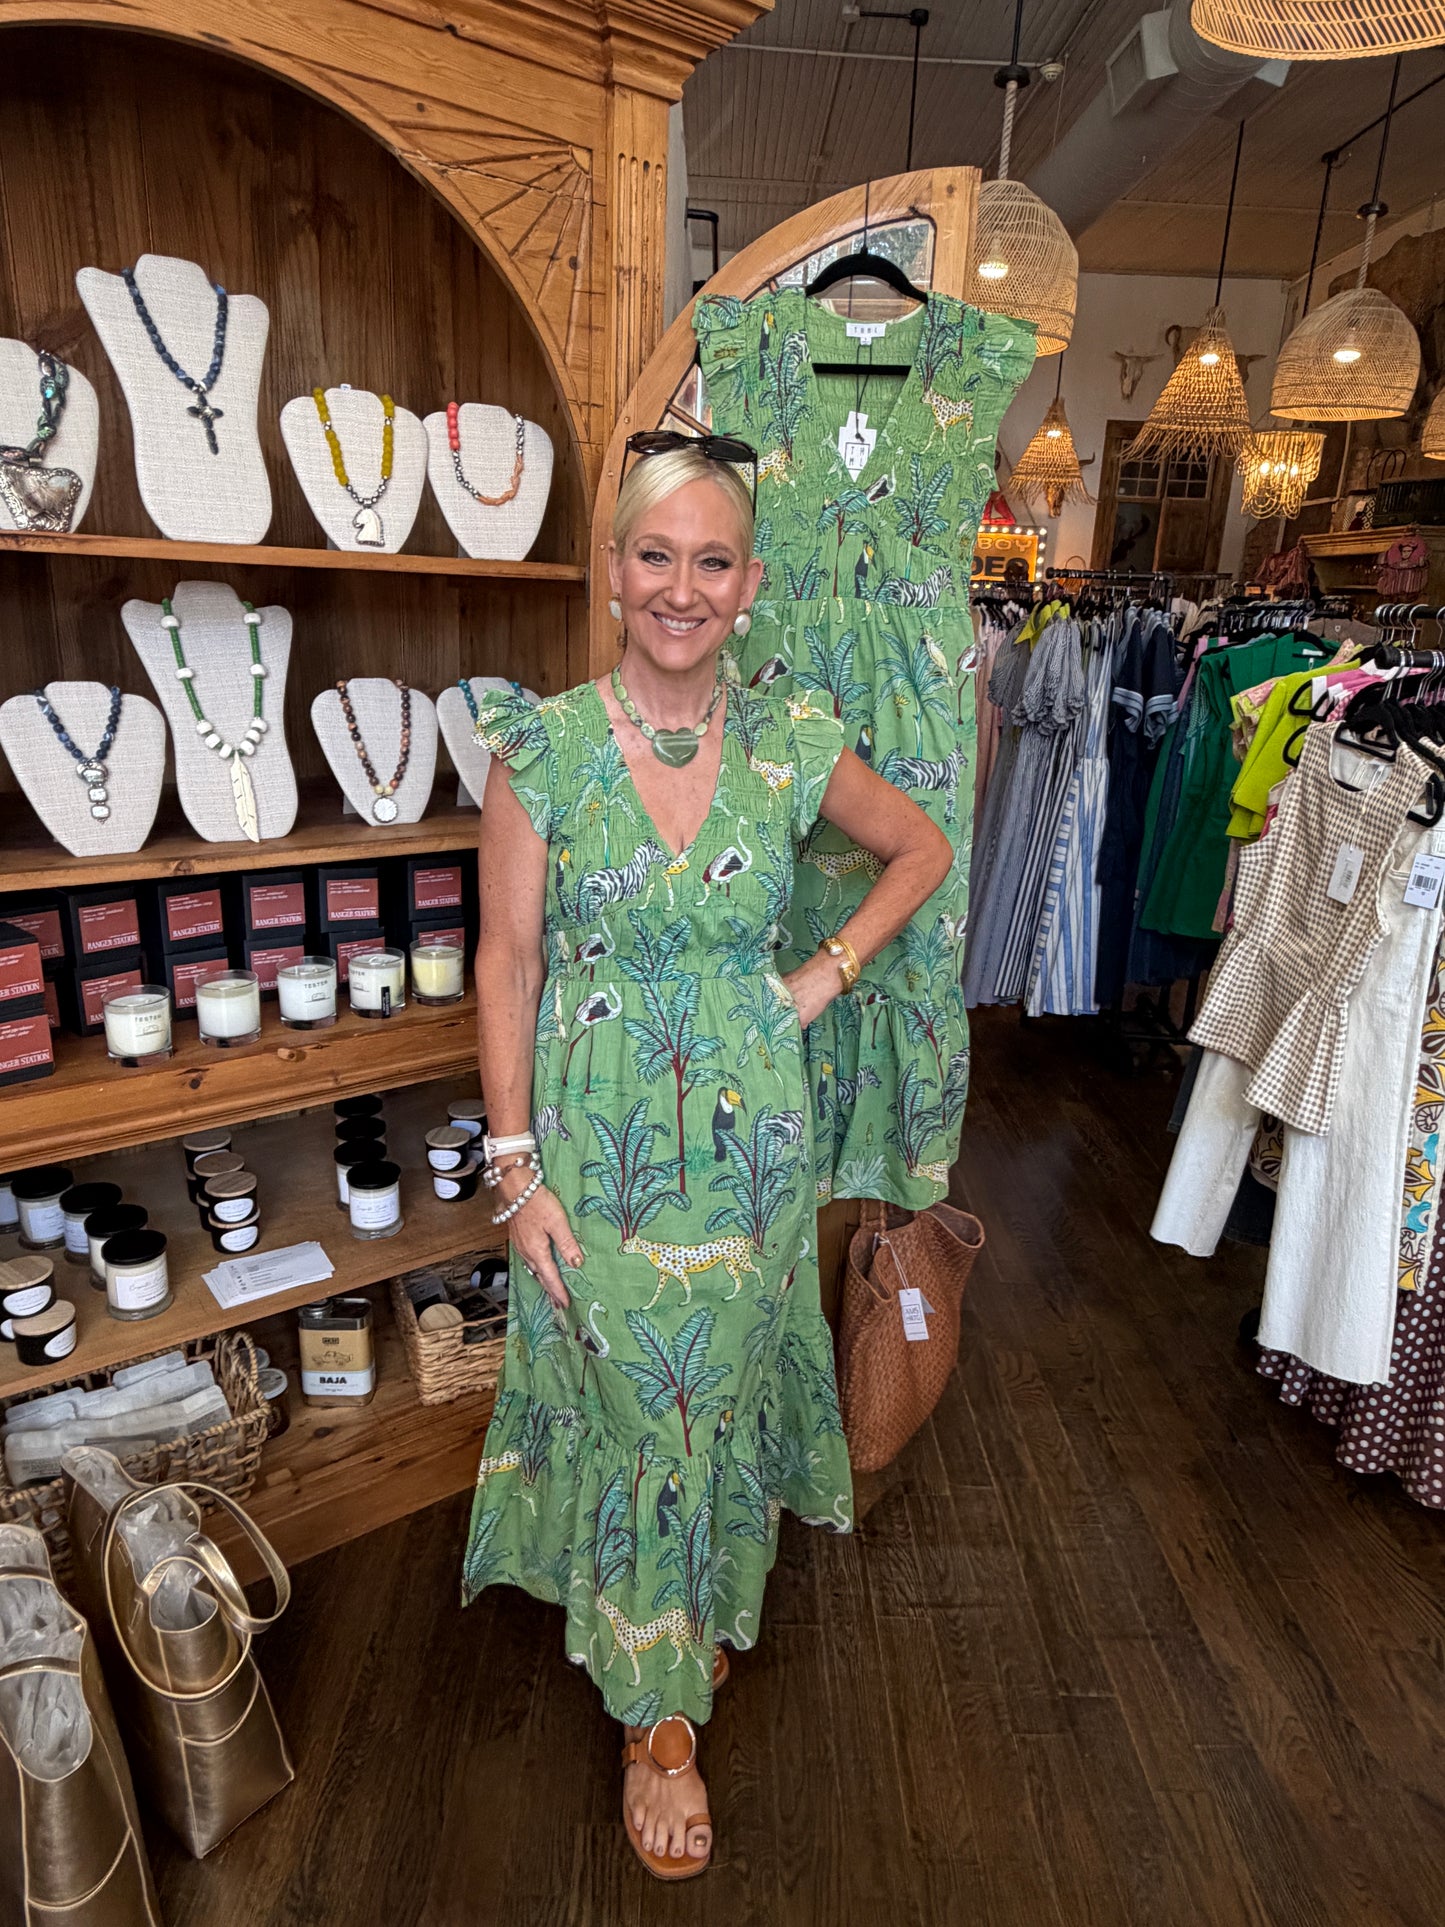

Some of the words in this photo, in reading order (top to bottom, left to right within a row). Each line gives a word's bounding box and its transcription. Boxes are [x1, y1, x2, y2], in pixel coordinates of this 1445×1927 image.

[978, 537, 1032, 552] BOY
[87, 938, 112, 950] RANGER
[113, 934, 138, 946] STATION
[11, 982, 39, 995] STATION
[20, 1051, 50, 1065] STATION
[319, 1376, 347, 1384] BAJA
